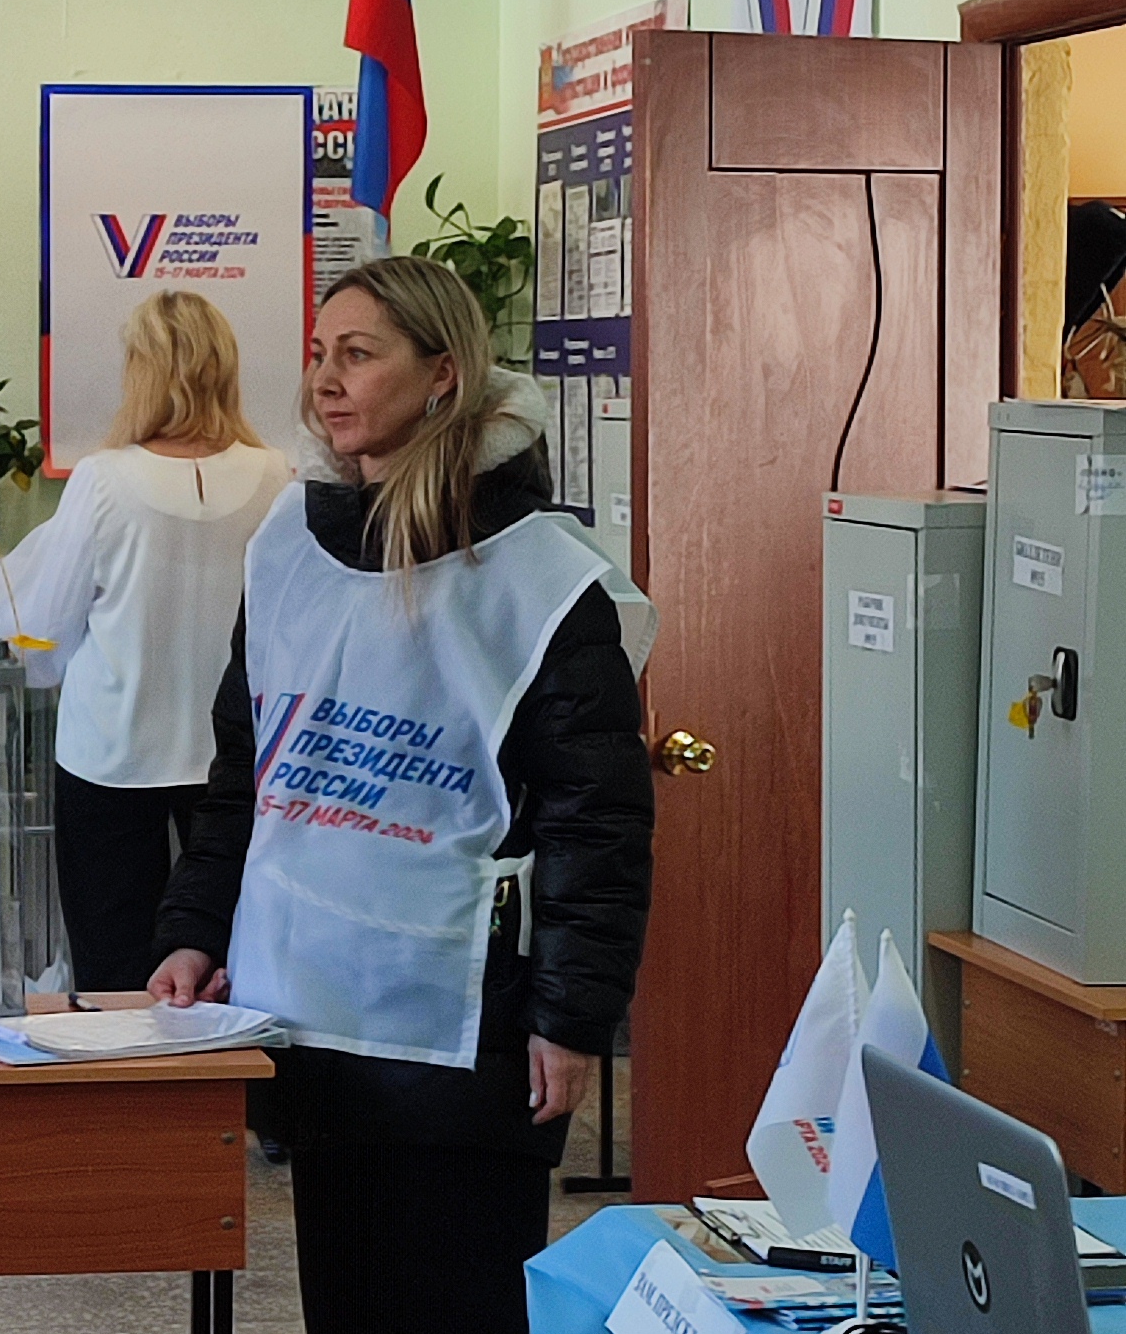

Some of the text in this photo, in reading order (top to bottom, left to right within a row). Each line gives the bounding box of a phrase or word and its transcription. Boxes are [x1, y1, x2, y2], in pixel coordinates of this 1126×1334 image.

[173, 214, 240, 228] ВЫБОРЫ
[165, 231, 259, 246] ПРЕЗИДЕНТА
[158, 249, 220, 263] РОССИИ
[310, 697, 444, 750] ВЫБОРЫ
[288, 729, 475, 794] ПРЕЗИДЕНТА
[269, 762, 388, 810] РОССИИ
[305, 803, 380, 833] МАРТА
